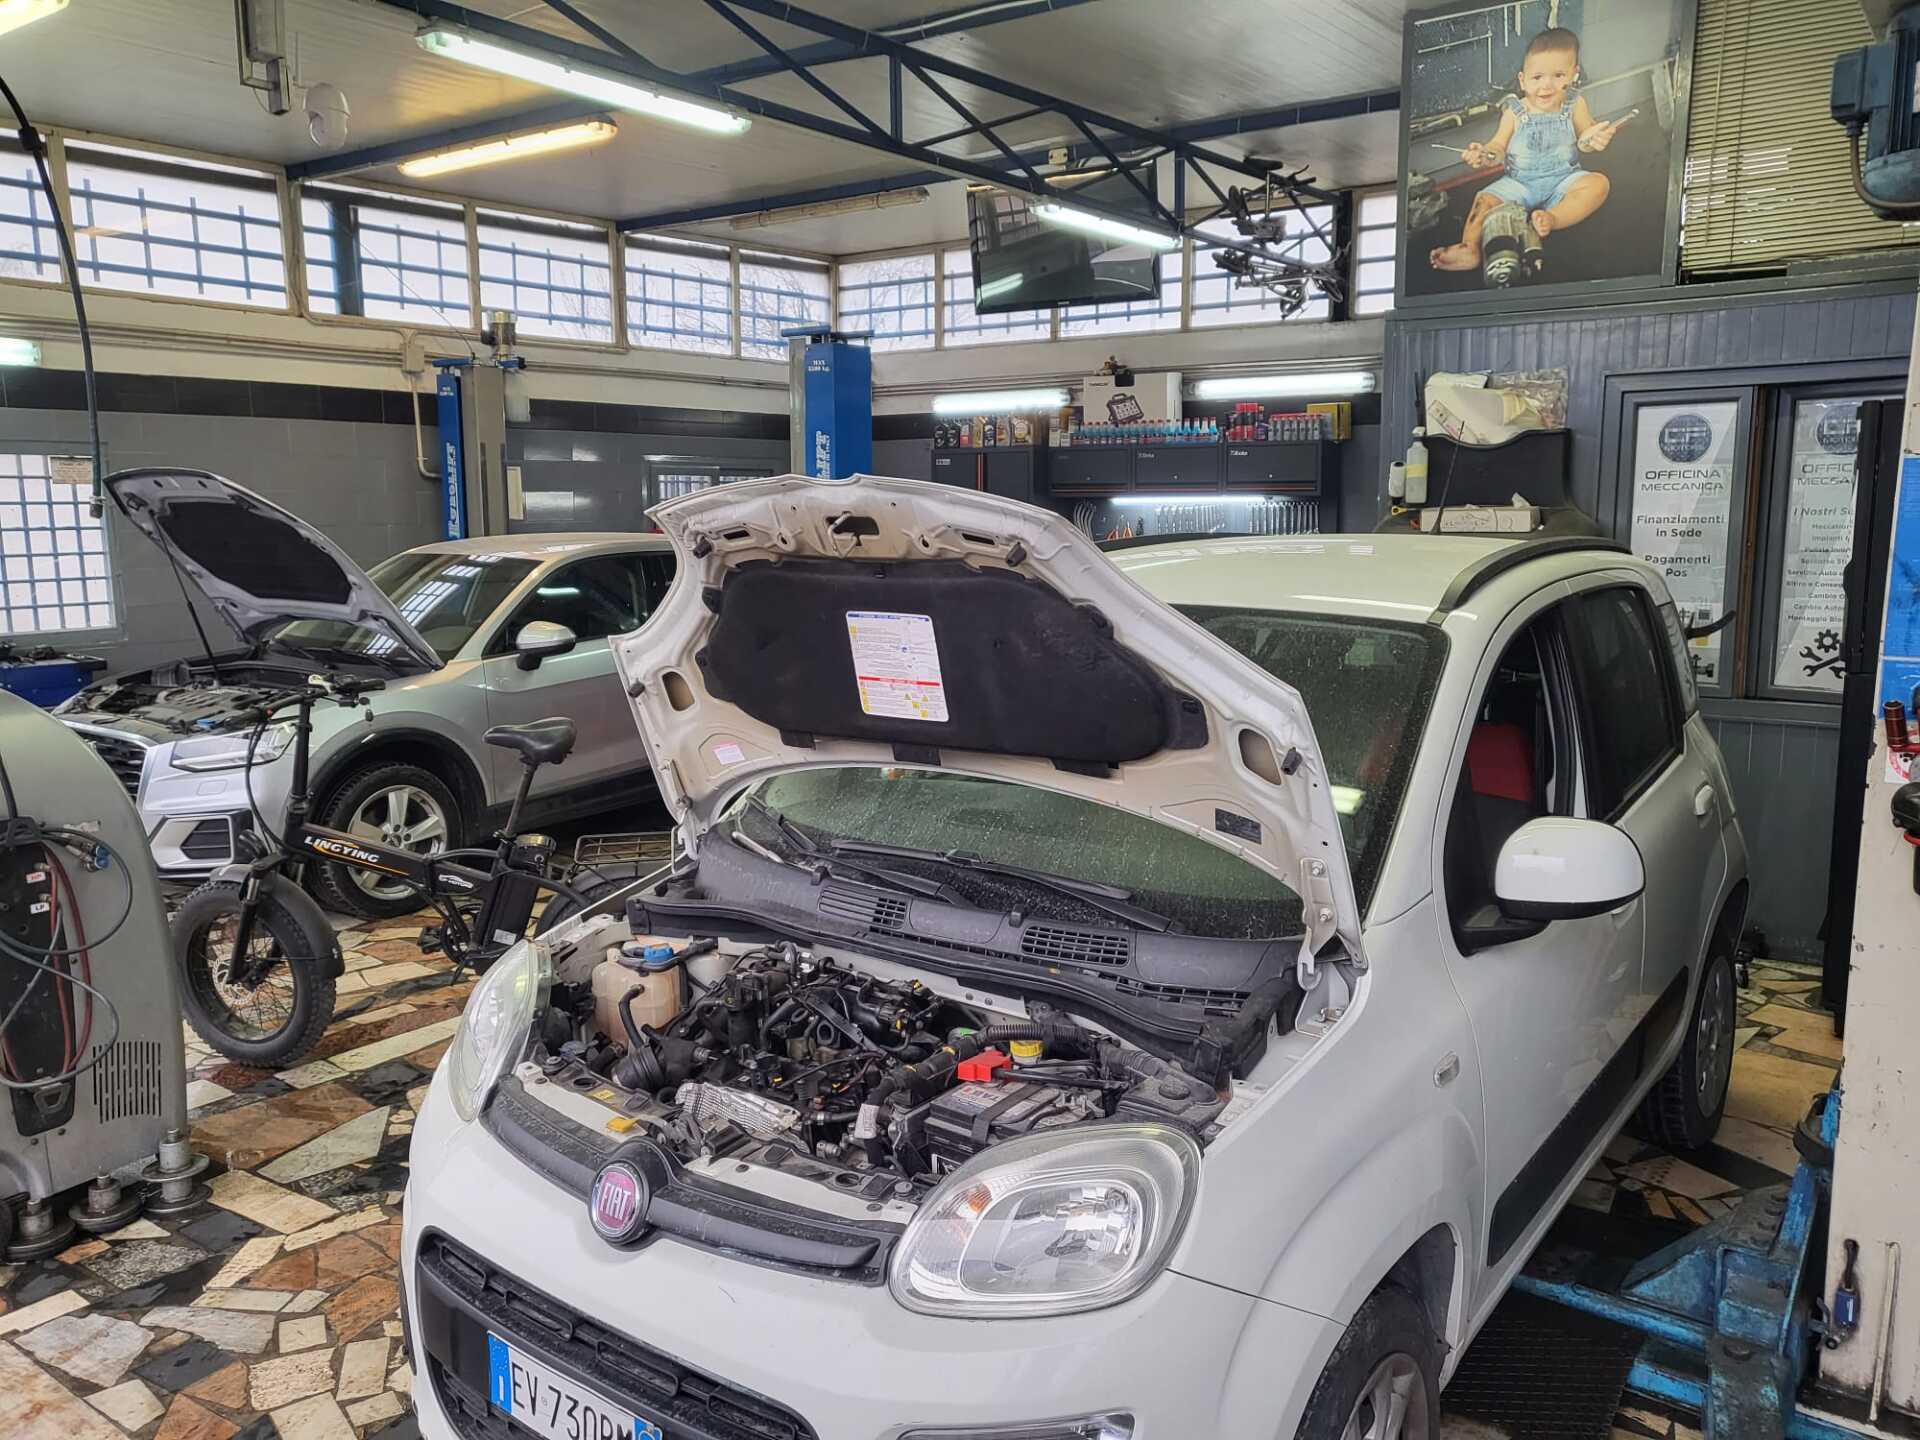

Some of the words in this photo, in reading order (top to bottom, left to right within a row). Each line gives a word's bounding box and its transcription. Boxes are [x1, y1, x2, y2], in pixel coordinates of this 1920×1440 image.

[1801, 463, 1853, 474] OFFIC
[1645, 469, 1721, 480] OFFICINA
[1641, 482, 1724, 492] MECCANICA
[1801, 507, 1837, 517] Nostri
[1636, 514, 1725, 525] Finanziamenti
[1671, 528, 1702, 538] Sede
[1645, 554, 1711, 566] Pagamenti
[1665, 567, 1688, 578] Pos
[304, 836, 380, 863] LINGYING
[600, 1182, 632, 1221] FIAT
[511, 1361, 538, 1417] EV
